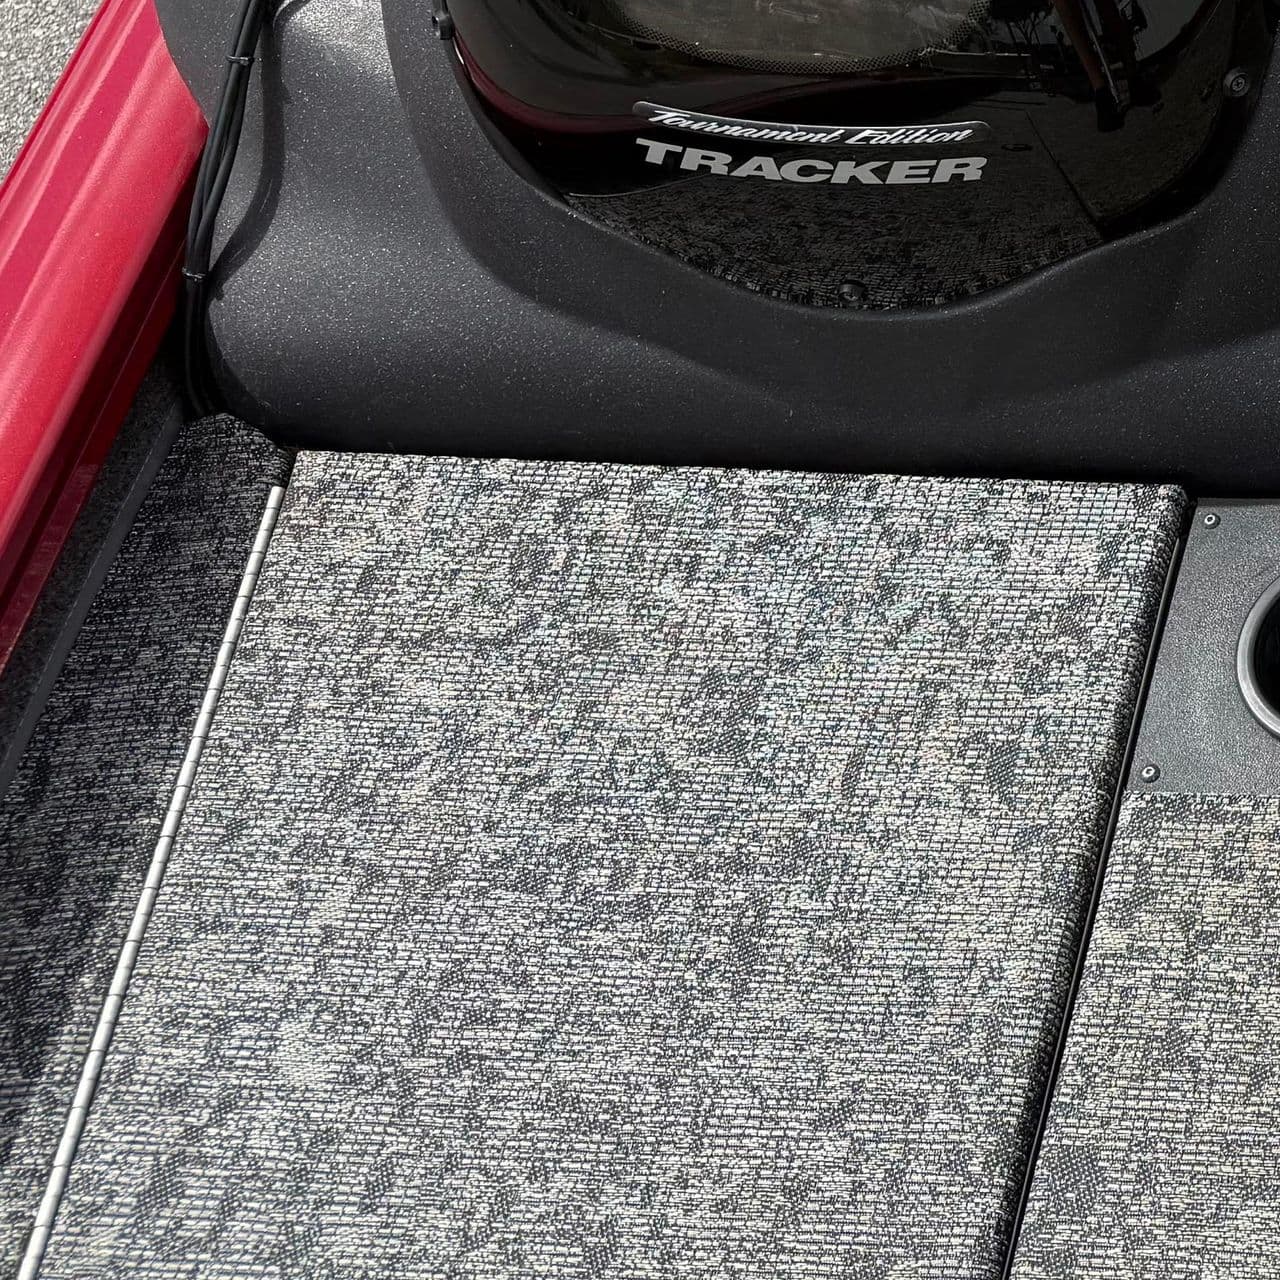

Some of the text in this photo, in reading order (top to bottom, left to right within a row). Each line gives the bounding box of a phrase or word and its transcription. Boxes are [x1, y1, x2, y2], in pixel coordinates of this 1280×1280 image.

[648, 110, 973, 145] Tournament Edition
[635, 138, 988, 185] TRACKER
